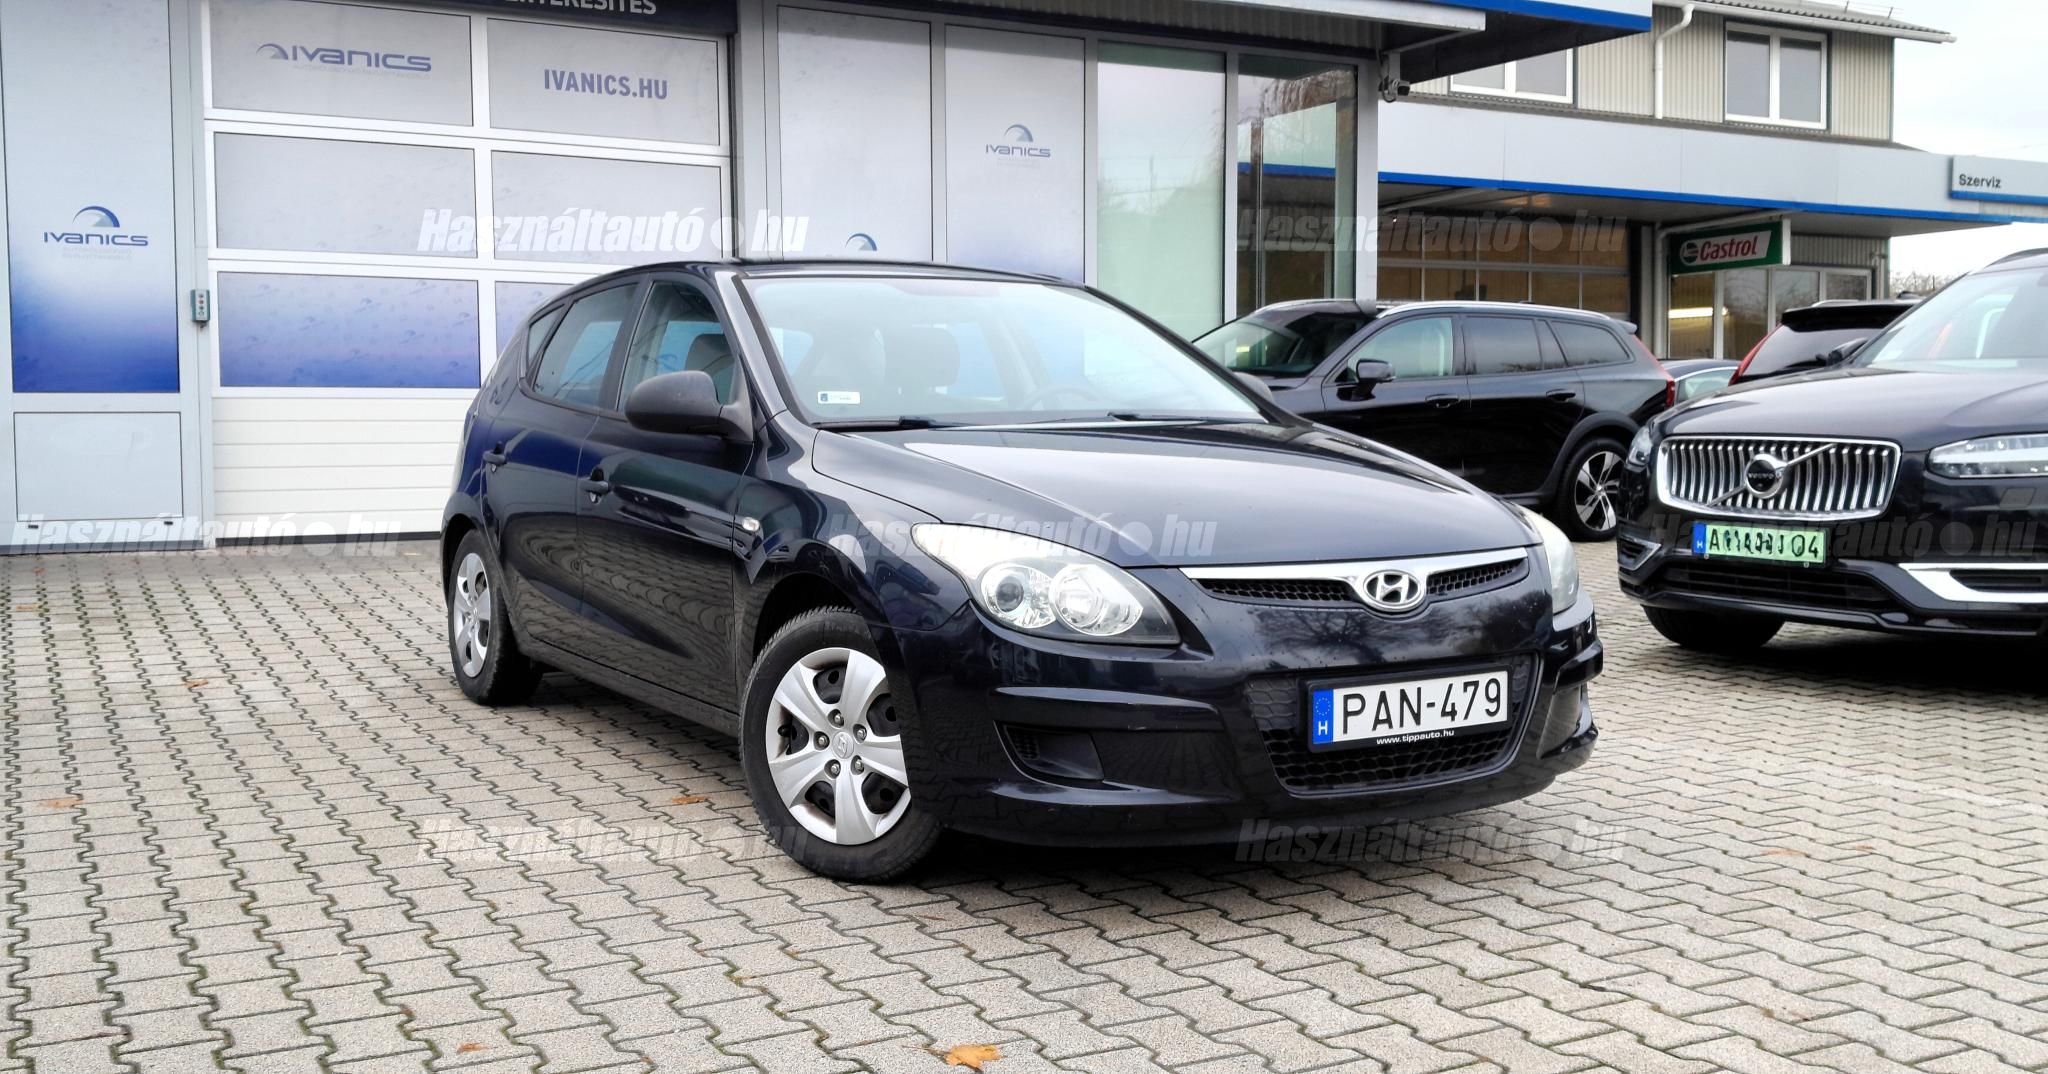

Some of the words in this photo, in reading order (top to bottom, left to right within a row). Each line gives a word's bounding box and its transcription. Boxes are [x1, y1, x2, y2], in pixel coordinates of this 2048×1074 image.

[544, 68, 668, 100] IVANICS.HU
[1958, 173, 2002, 189] Szerviz
[1700, 235, 1759, 261] Castrol
[1341, 677, 1502, 735] PAN-479
[1317, 720, 1328, 736] H
[1376, 729, 1455, 745] www.tippauto.hu
